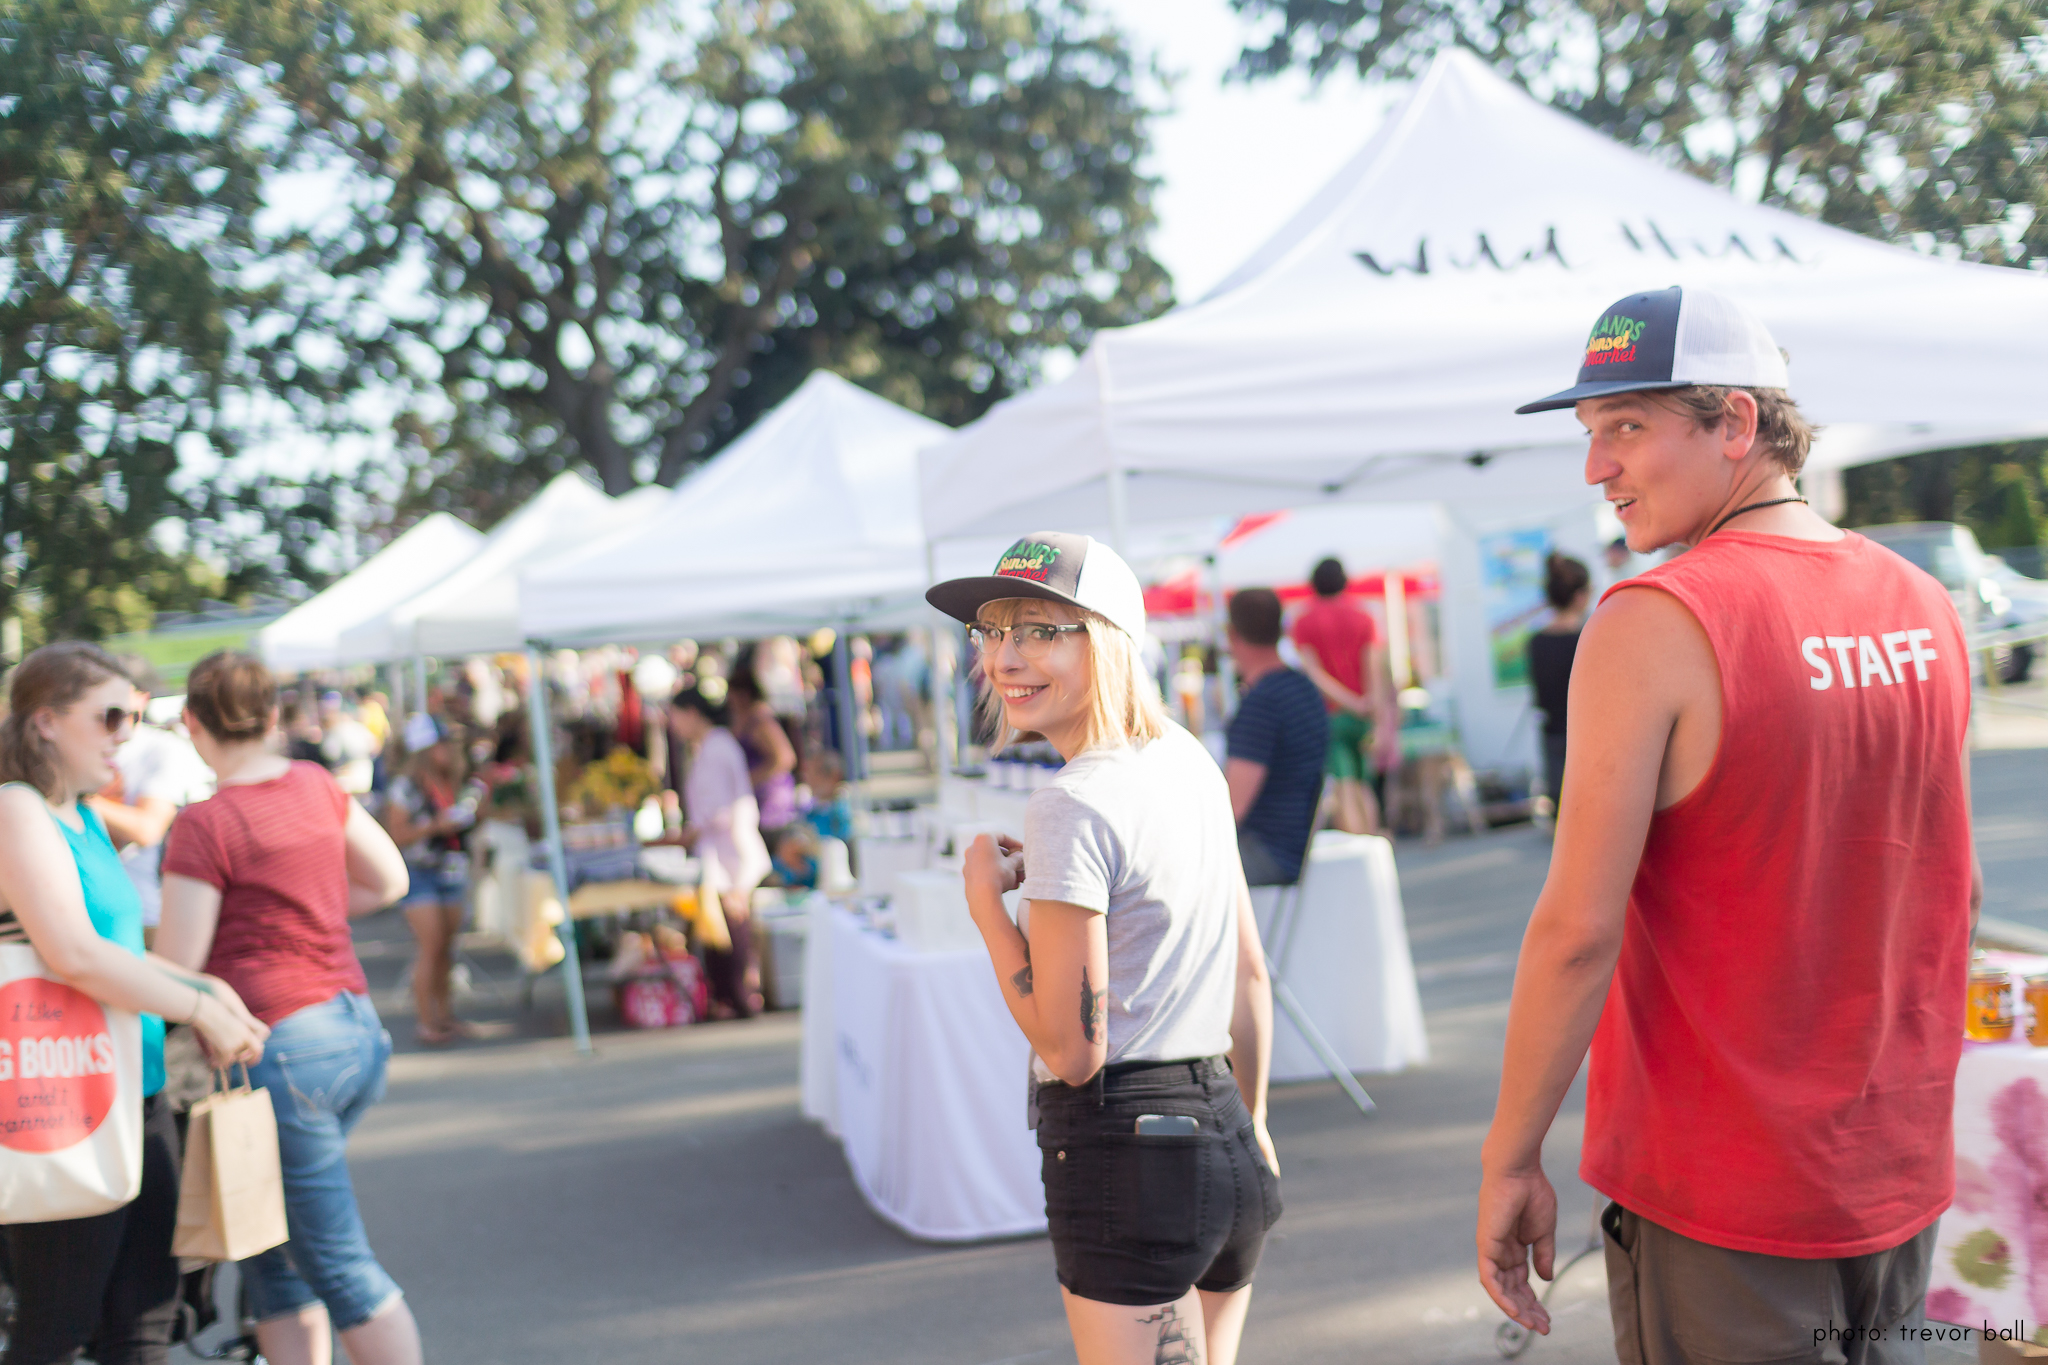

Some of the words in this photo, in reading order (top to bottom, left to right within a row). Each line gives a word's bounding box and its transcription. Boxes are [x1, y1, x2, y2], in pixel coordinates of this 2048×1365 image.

[1587, 330, 1630, 355] Sunset
[1584, 345, 1636, 367] Market
[998, 554, 1043, 573] Sunset
[1801, 628, 1938, 691] STAFF
[18, 1032, 115, 1079] BOOKS
[17, 1086, 57, 1108] and
